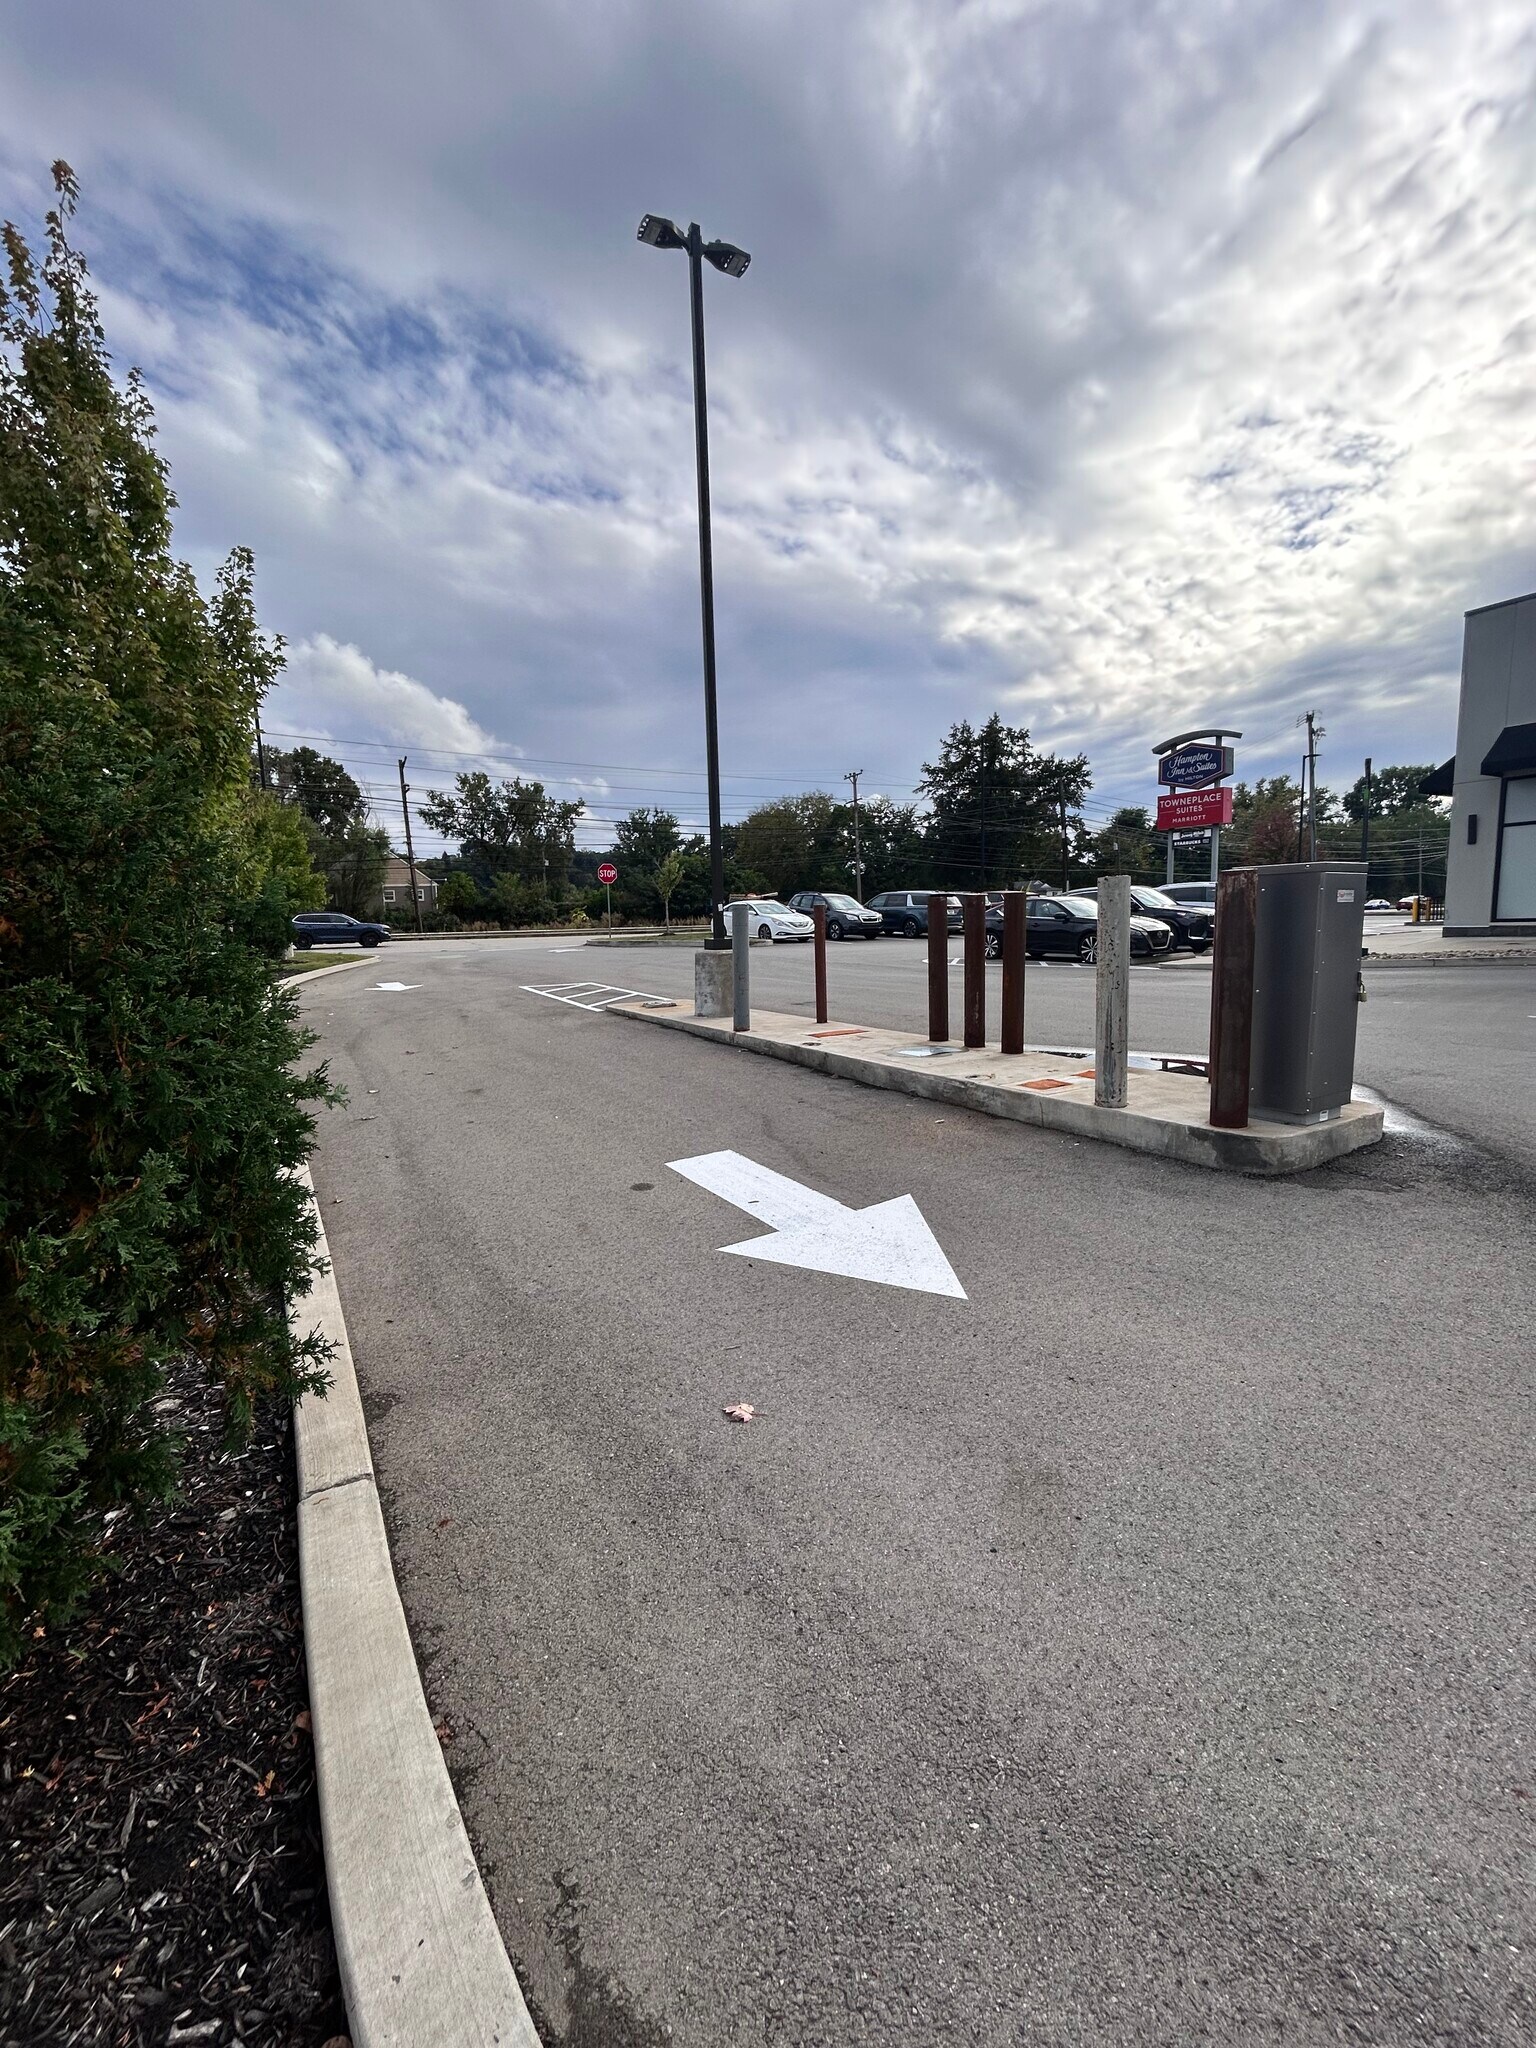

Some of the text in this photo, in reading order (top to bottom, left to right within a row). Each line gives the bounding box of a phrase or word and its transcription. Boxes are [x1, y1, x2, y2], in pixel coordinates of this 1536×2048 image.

[1169, 753, 1213, 769] Hampton
[1167, 768, 1187, 778] Inn
[1193, 762, 1217, 772] Suites
[1160, 793, 1222, 808] TOWNEPLACE
[1176, 805, 1203, 815] SUITES
[1172, 815, 1206, 823] MARRIOTT
[600, 870, 616, 878] STOP
